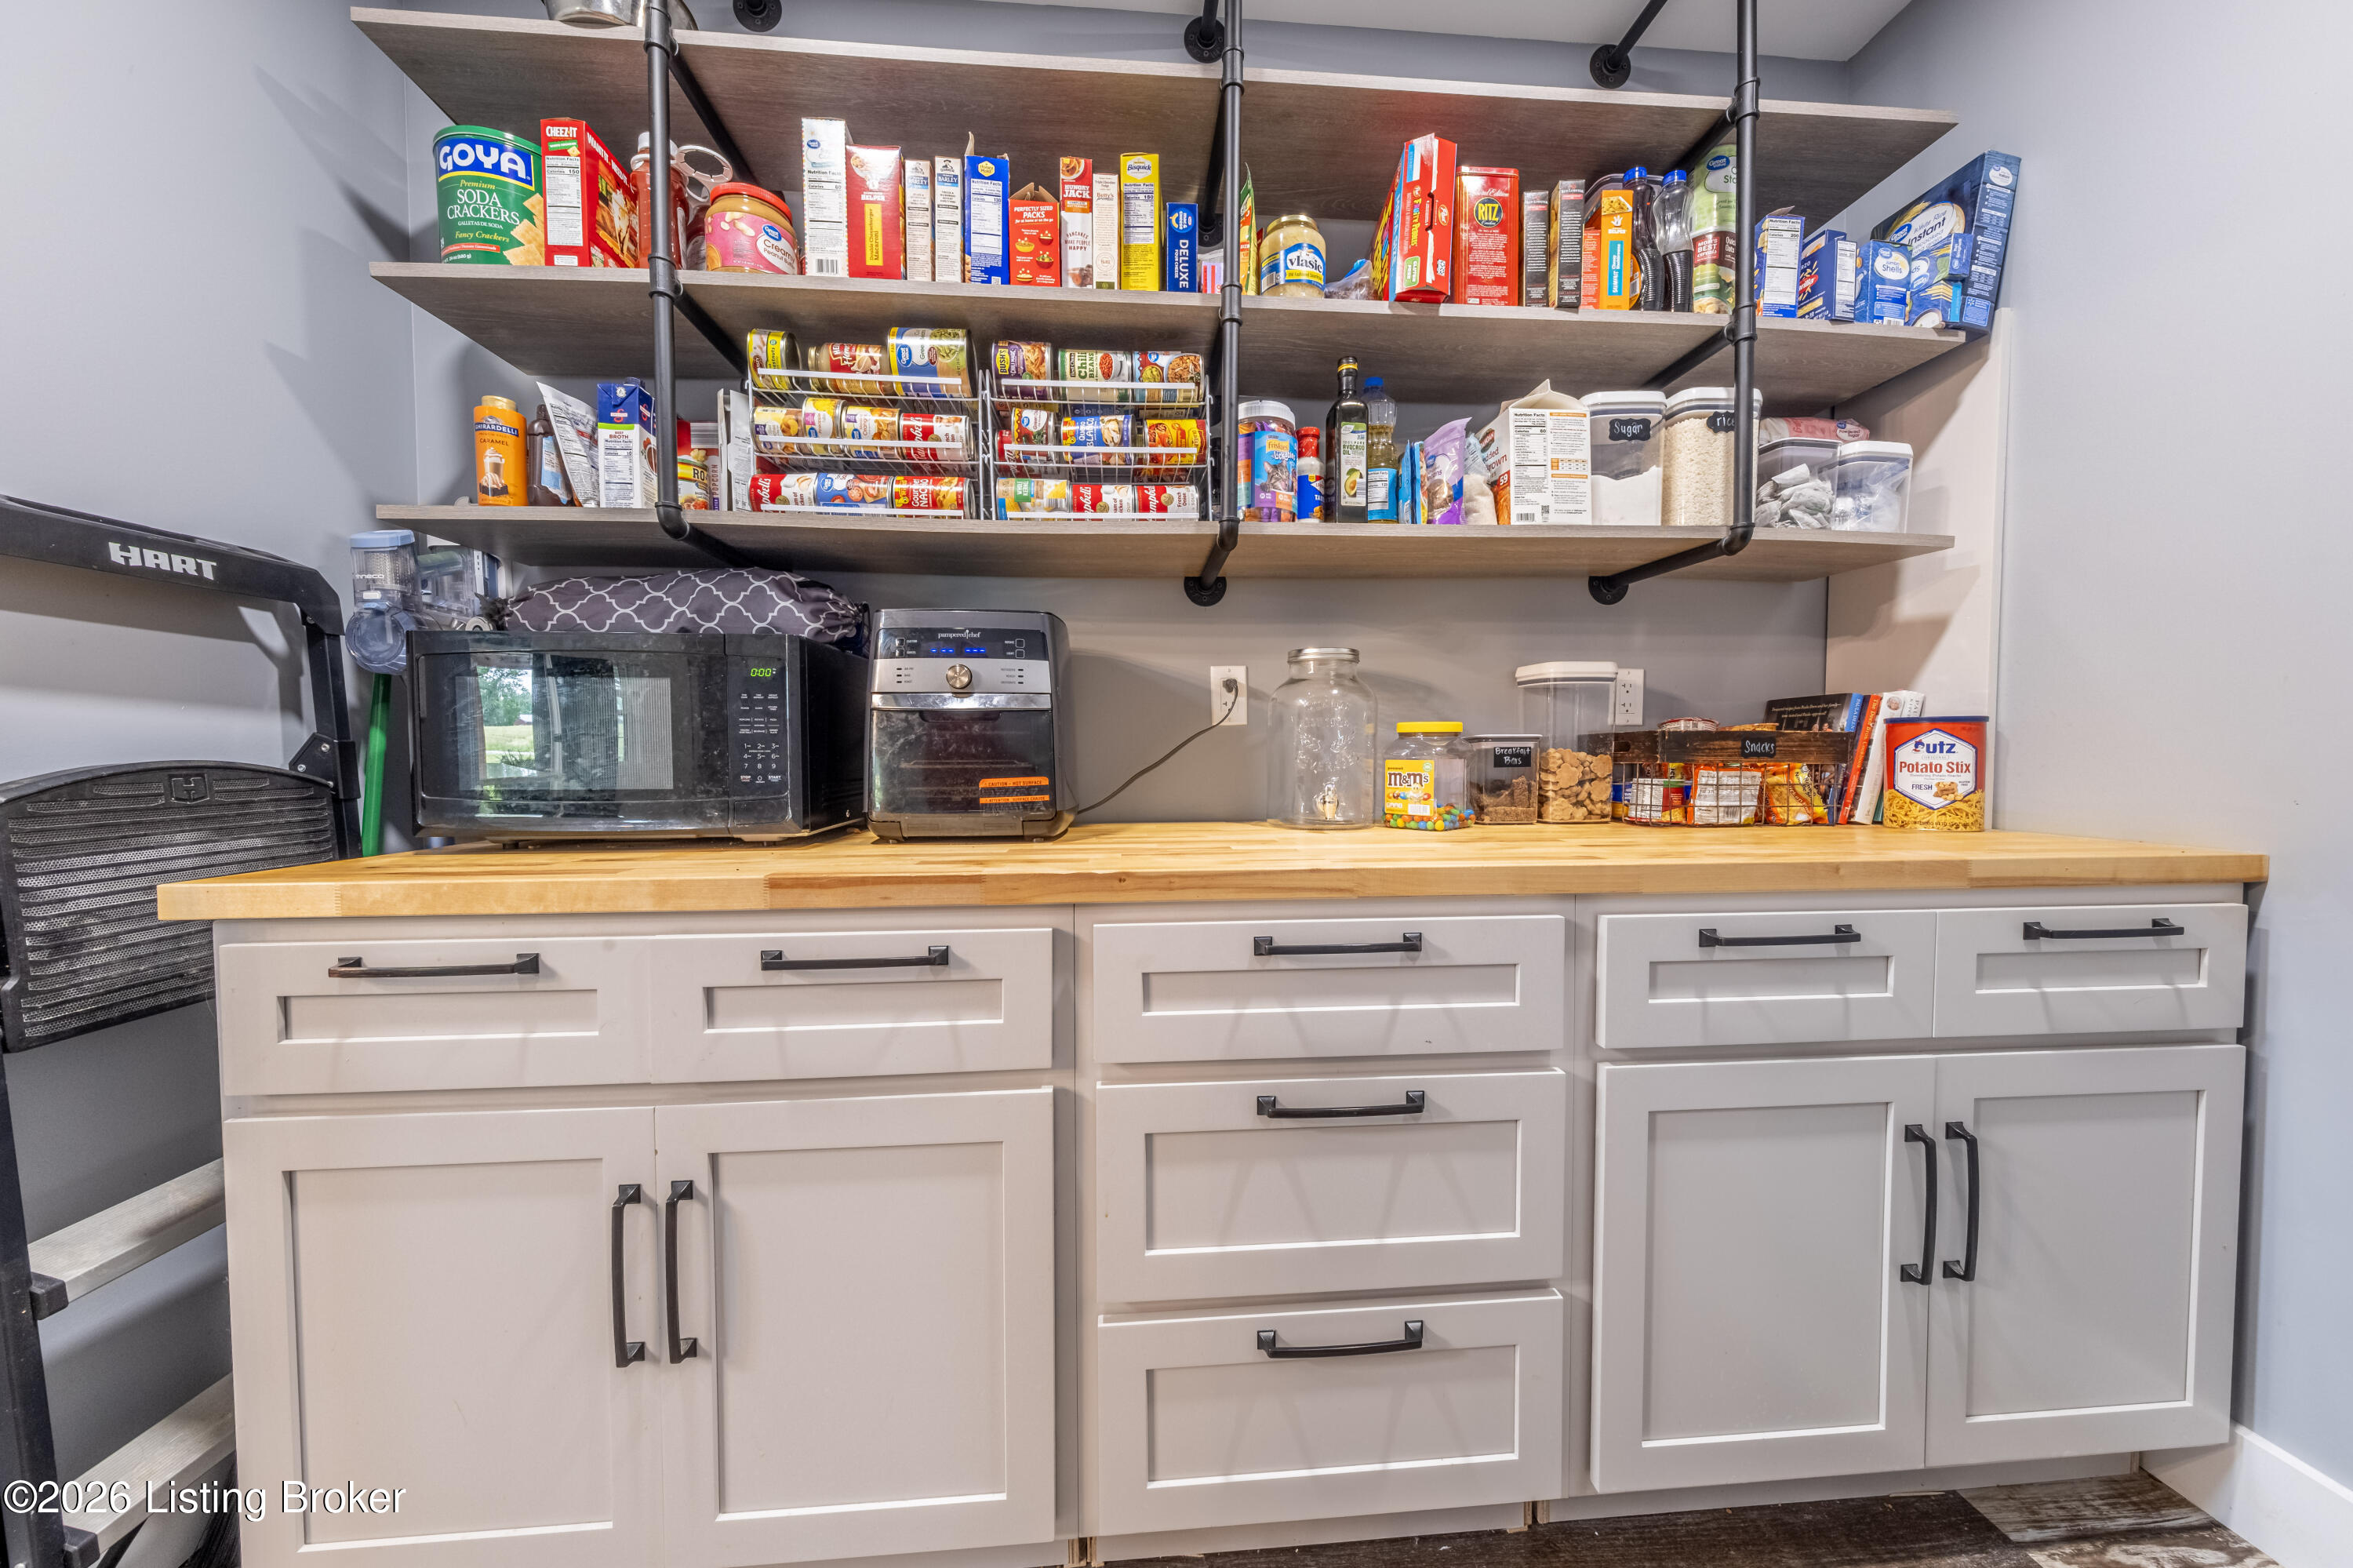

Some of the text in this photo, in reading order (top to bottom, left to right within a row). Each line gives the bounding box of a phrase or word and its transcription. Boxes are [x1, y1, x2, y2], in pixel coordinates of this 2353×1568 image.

[439, 143, 526, 179] GOYA
[1709, 158, 1727, 166] Great
[460, 180, 496, 190] Premium
[456, 189, 502, 208] SODA
[1063, 190, 1090, 198] JACK
[447, 206, 520, 225] CRACKERS
[1478, 202, 1500, 222] RITZ
[455, 231, 509, 242] Fancy Crackers
[1907, 217, 1946, 246] Instant
[763, 238, 795, 264] Creamy
[763, 247, 784, 260] Peanut
[1697, 244, 1718, 253] BEST
[1725, 245, 1735, 253] Oats
[1179, 239, 1189, 289] DELUXE
[1288, 255, 1323, 274] vlasic
[1882, 264, 1903, 275] Shells
[1078, 351, 1087, 380] Chili
[475, 424, 518, 436] GHIRARDELLI
[1613, 420, 1643, 437] Sugar
[480, 438, 509, 446] CARAMEL
[1268, 442, 1289, 450] Friskies
[1499, 473, 1508, 485] 59
[108, 541, 217, 580] HART
[750, 668, 772, 677] 0:00
[1867, 709, 1876, 723] Deen
[1744, 740, 1775, 754] Snacks
[1926, 741, 1956, 754] utz
[1504, 755, 1522, 765] Bars
[1899, 761, 1971, 773] Potato Stix
